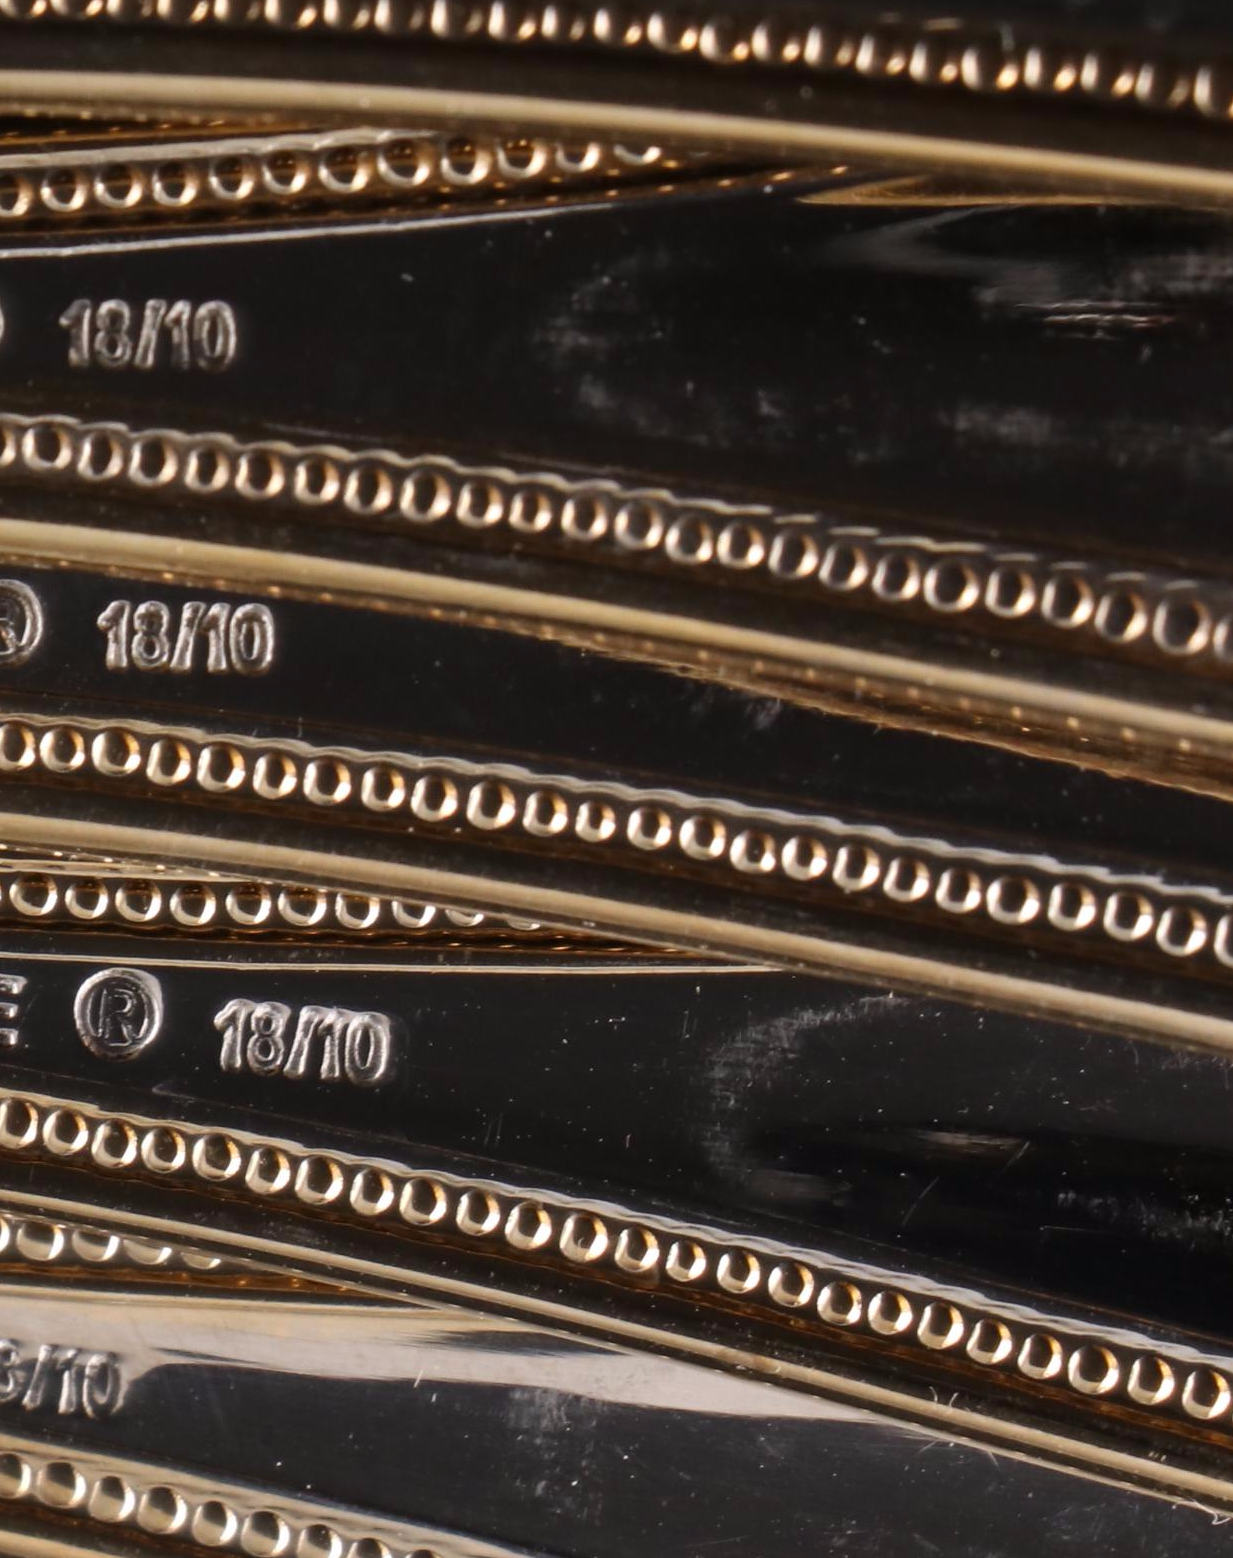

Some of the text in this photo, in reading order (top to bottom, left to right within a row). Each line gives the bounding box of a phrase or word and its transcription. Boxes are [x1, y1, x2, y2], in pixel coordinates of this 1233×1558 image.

[59, 298, 238, 372] 18/10
[97, 599, 276, 675] 18/10
[213, 997, 392, 1084] 18/10
